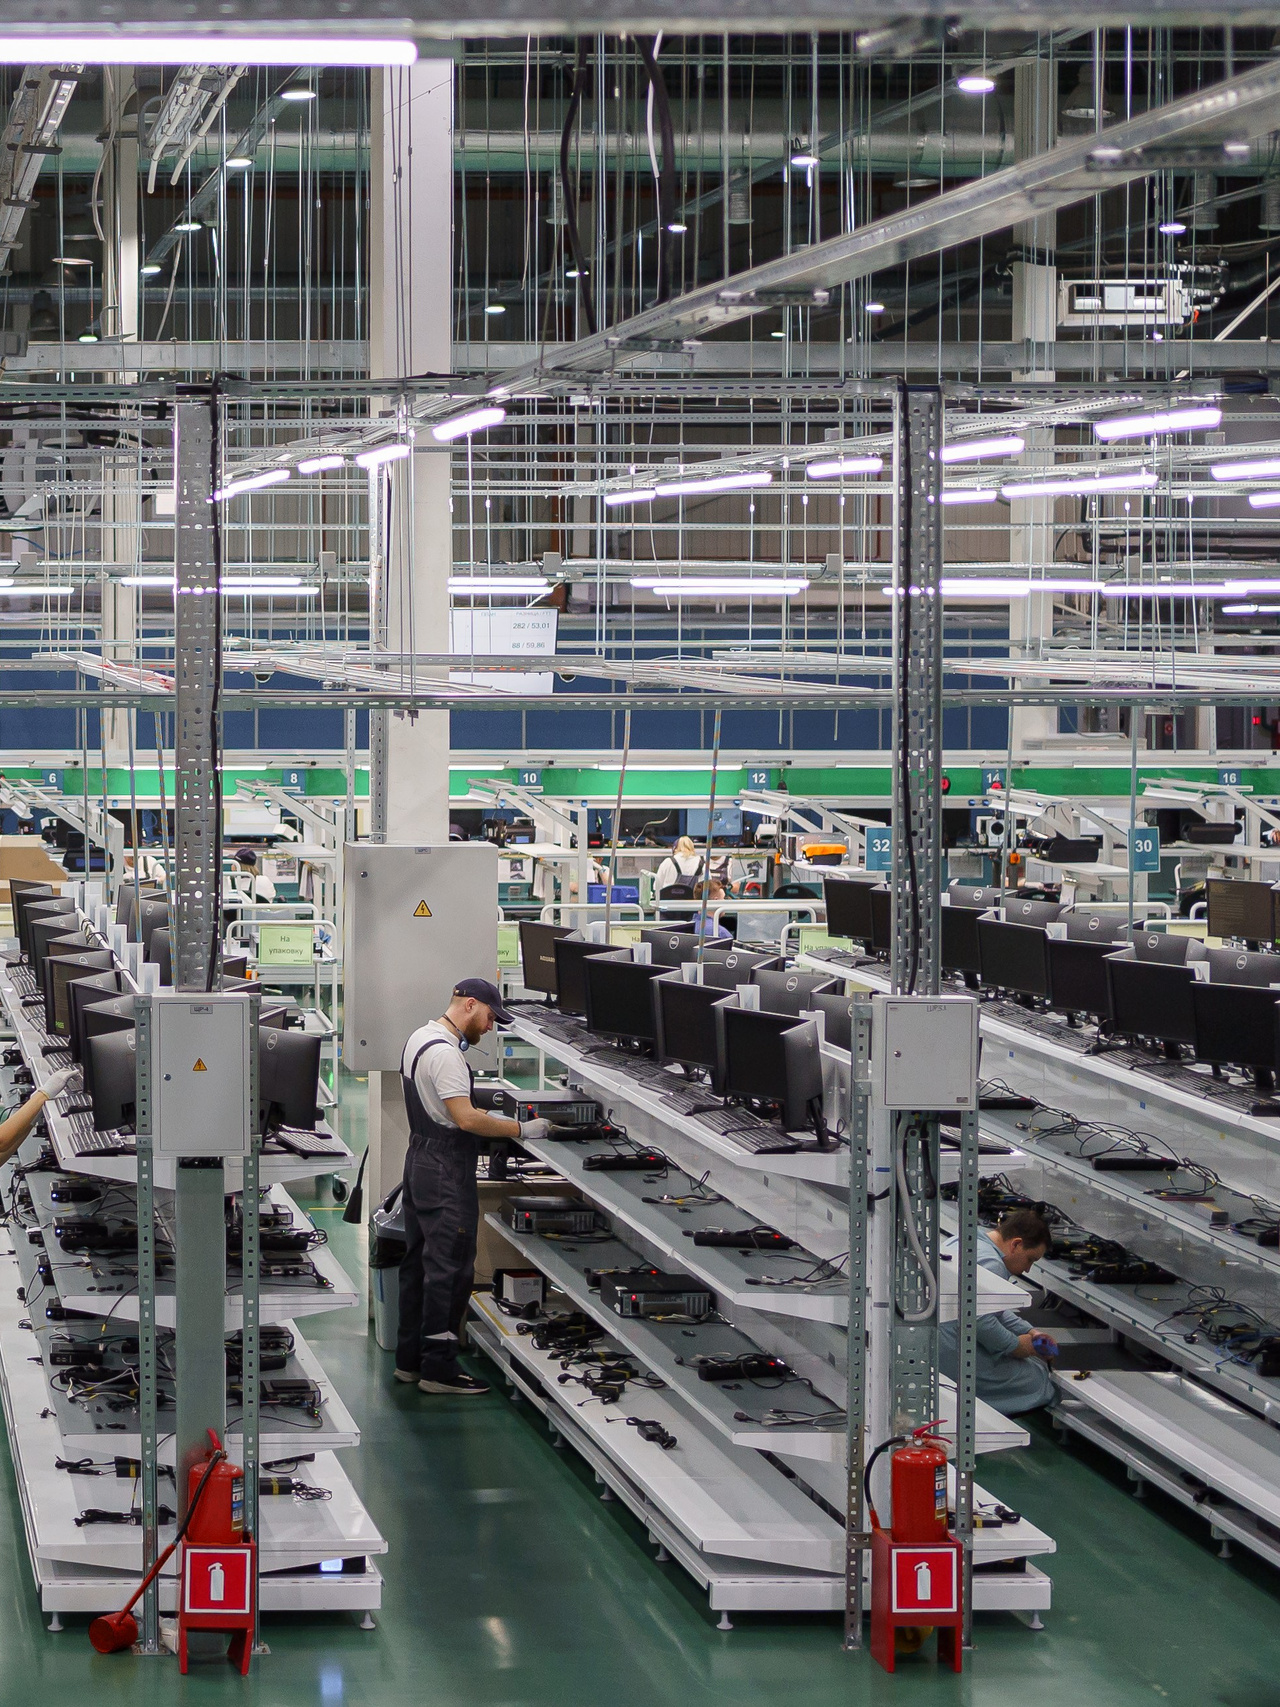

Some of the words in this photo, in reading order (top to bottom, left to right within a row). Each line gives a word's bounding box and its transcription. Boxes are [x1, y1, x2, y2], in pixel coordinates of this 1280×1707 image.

[48, 772, 57, 784] 6
[290, 772, 298, 784] 8
[523, 772, 537, 784] 10
[752, 772, 766, 784] 12
[1223, 772, 1237, 784] 16
[872, 838, 890, 852] 32
[1135, 839, 1153, 853] 30
[280, 935, 291, 943] На
[268, 947, 304, 956] упаковку
